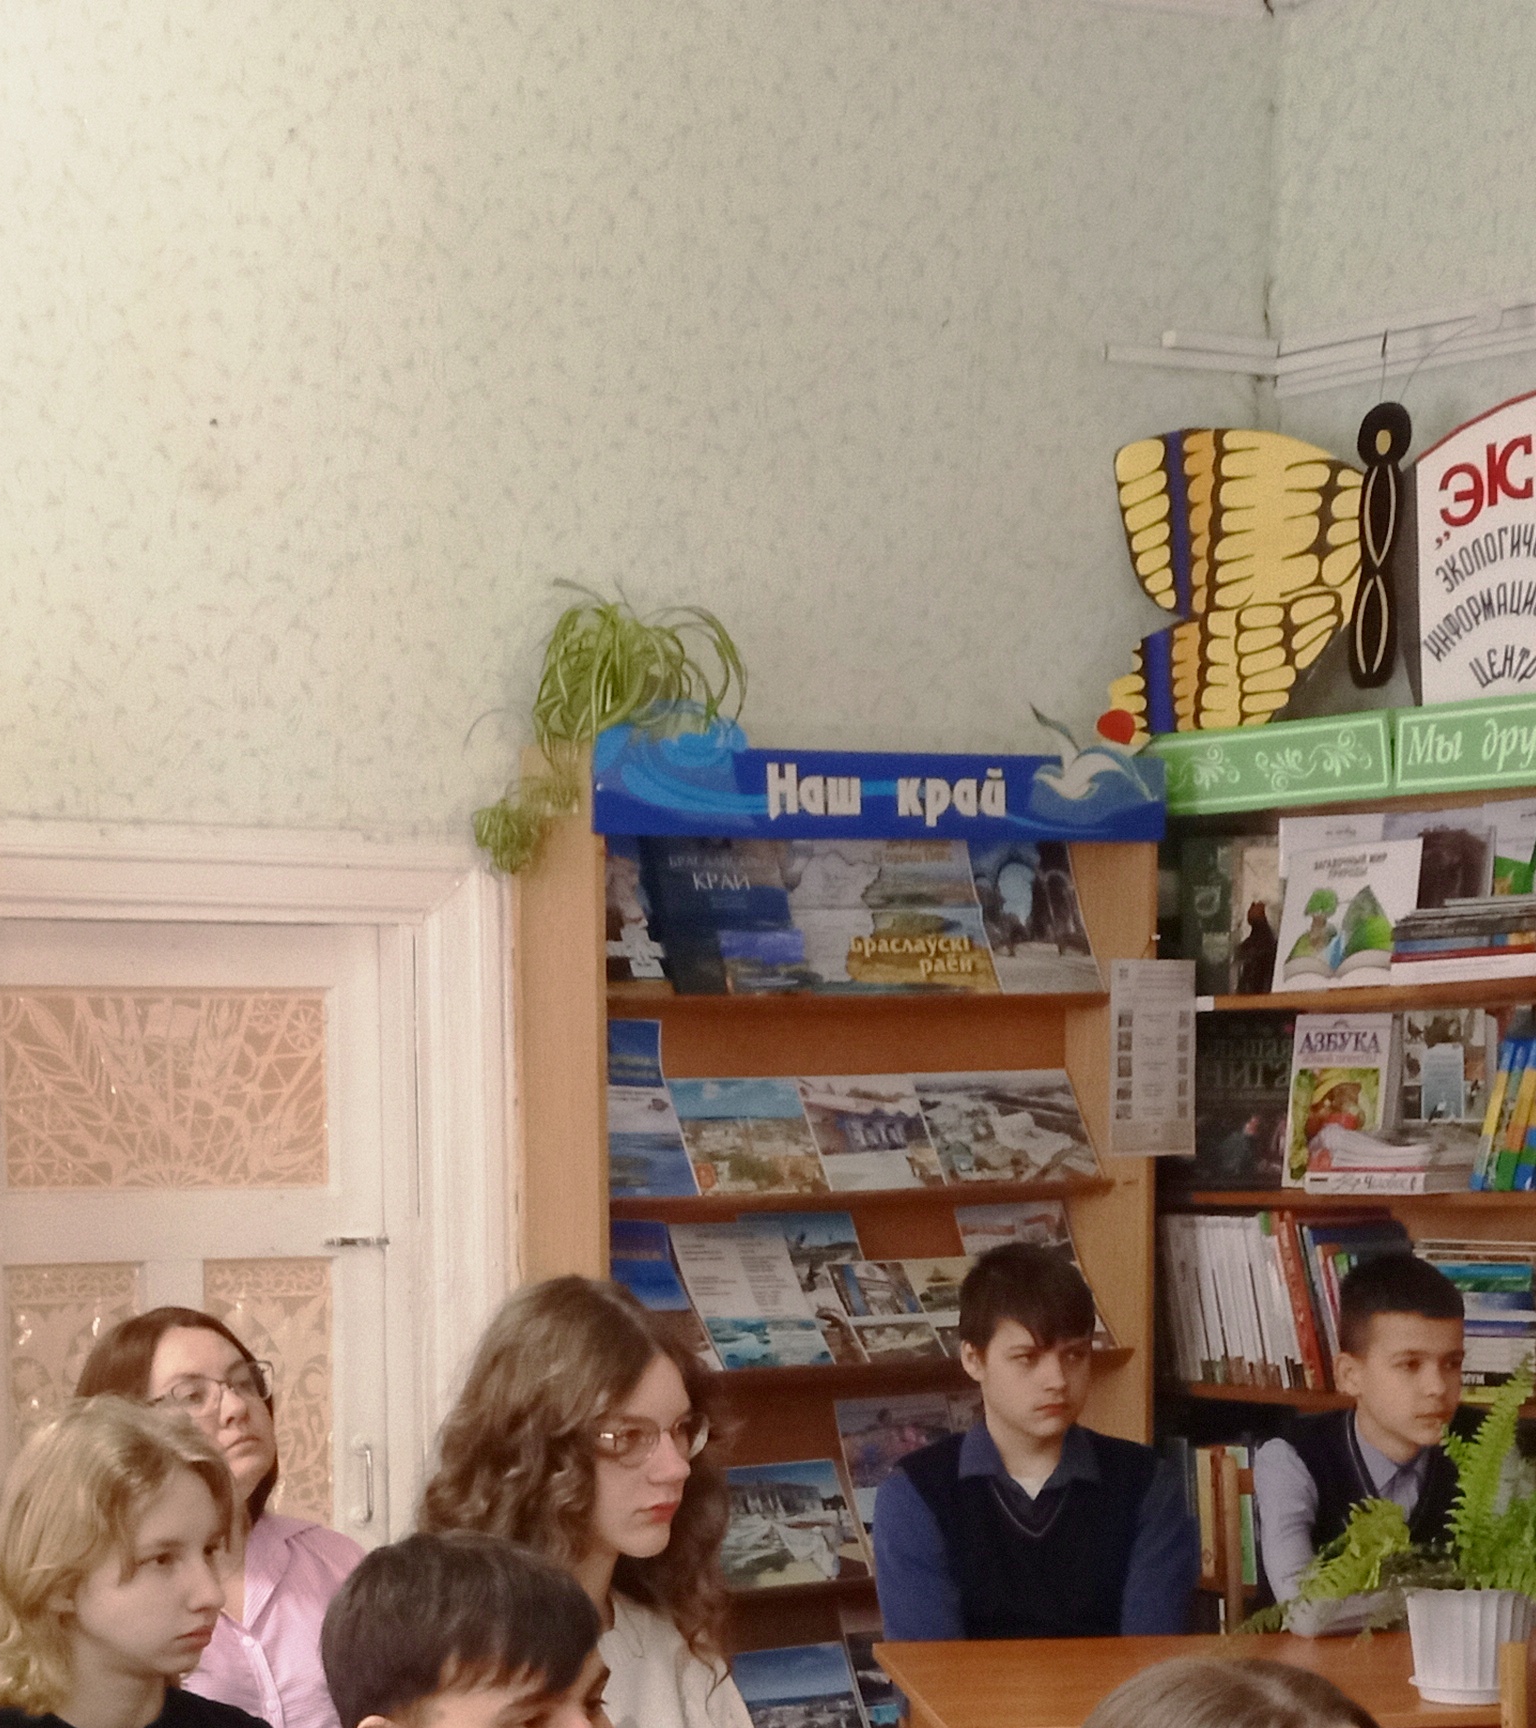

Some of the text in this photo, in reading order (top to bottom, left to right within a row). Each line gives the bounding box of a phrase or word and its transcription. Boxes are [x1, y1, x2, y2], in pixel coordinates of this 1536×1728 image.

[1406, 724, 1463, 766] Мы
[766, 761, 1007, 827] Наш край
[1300, 1031, 1382, 1053] АЗБУКА
